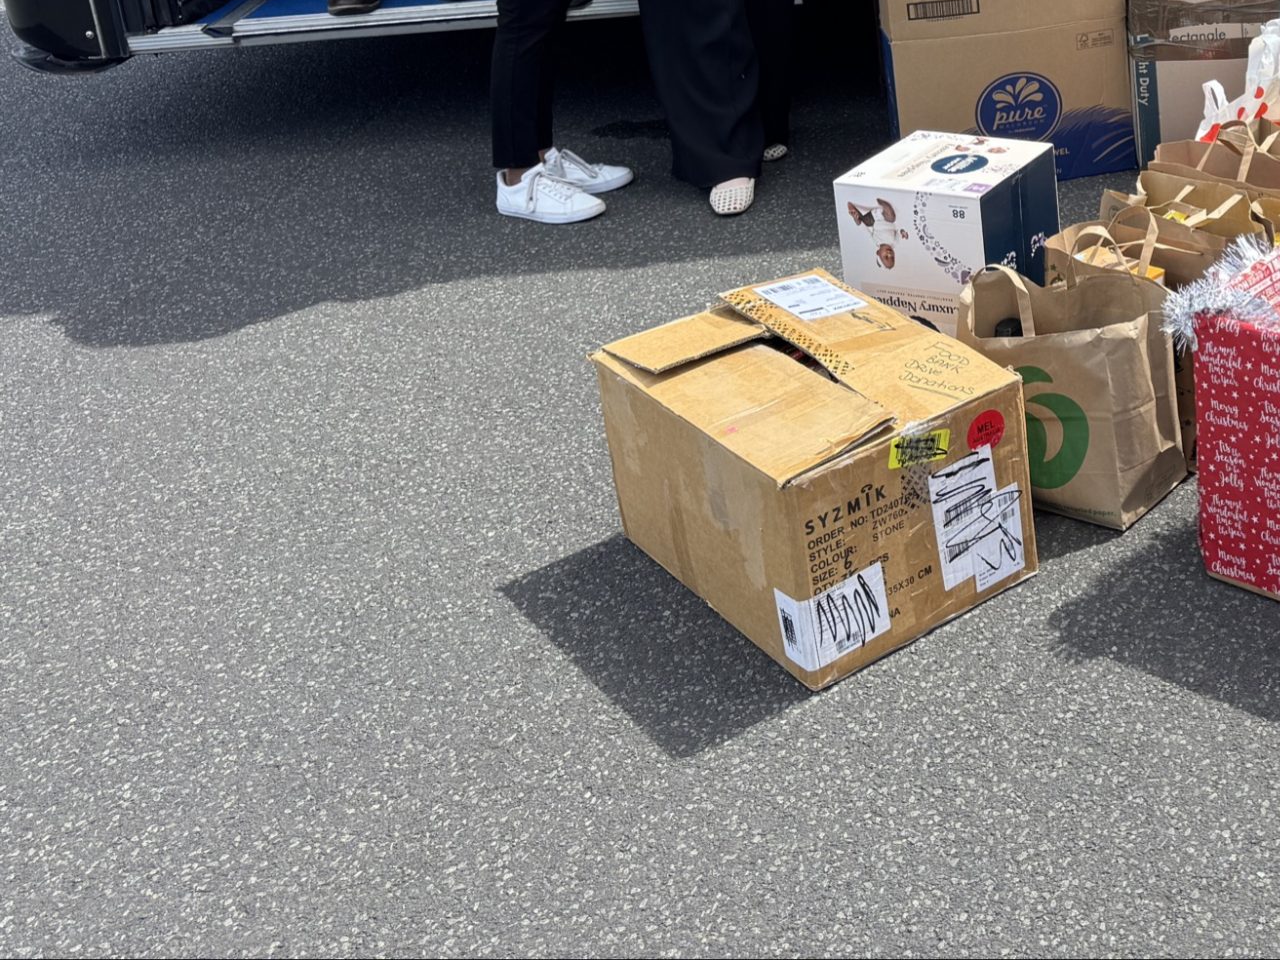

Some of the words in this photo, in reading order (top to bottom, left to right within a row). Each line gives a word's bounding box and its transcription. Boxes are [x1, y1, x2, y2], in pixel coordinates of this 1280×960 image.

[1138, 78, 1150, 106] Duty
[993, 106, 1047, 131] pure
[952, 208, 966, 220] 88
[977, 420, 995, 435] MEL
[807, 526, 845, 550] ORDER
[850, 515, 868, 530] NO:
[809, 538, 846, 562] STYLE:
[810, 545, 857, 573] COLOUR:
[873, 520, 905, 542] STONE
[812, 566, 838, 586] SIZE:
[917, 564, 933, 580] CM
